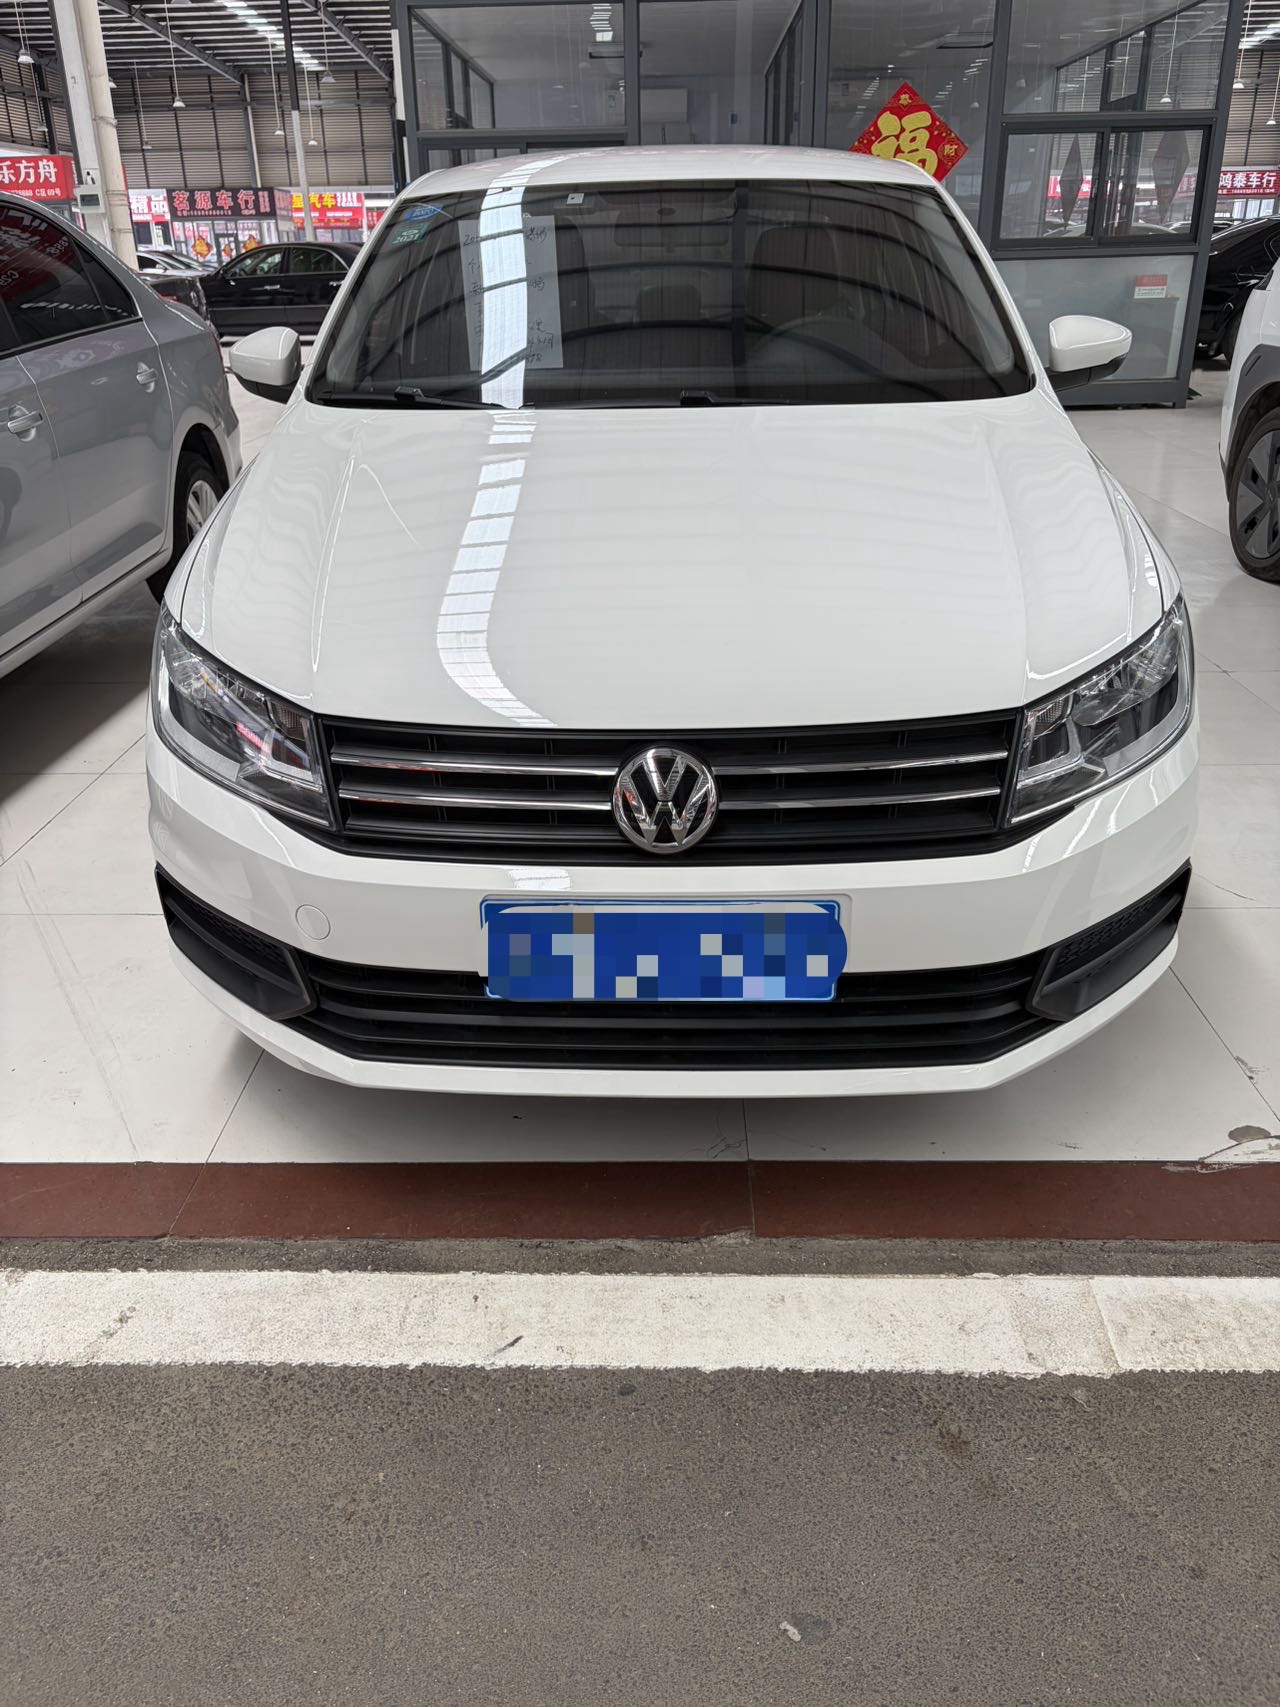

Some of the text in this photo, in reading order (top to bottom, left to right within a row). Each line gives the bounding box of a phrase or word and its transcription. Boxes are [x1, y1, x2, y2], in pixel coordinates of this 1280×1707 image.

[871, 111, 939, 177] 福
[943, 143, 958, 156] 财
[1218, 171, 1277, 189] 鸿泰车行
[614, 748, 716, 853] VW
